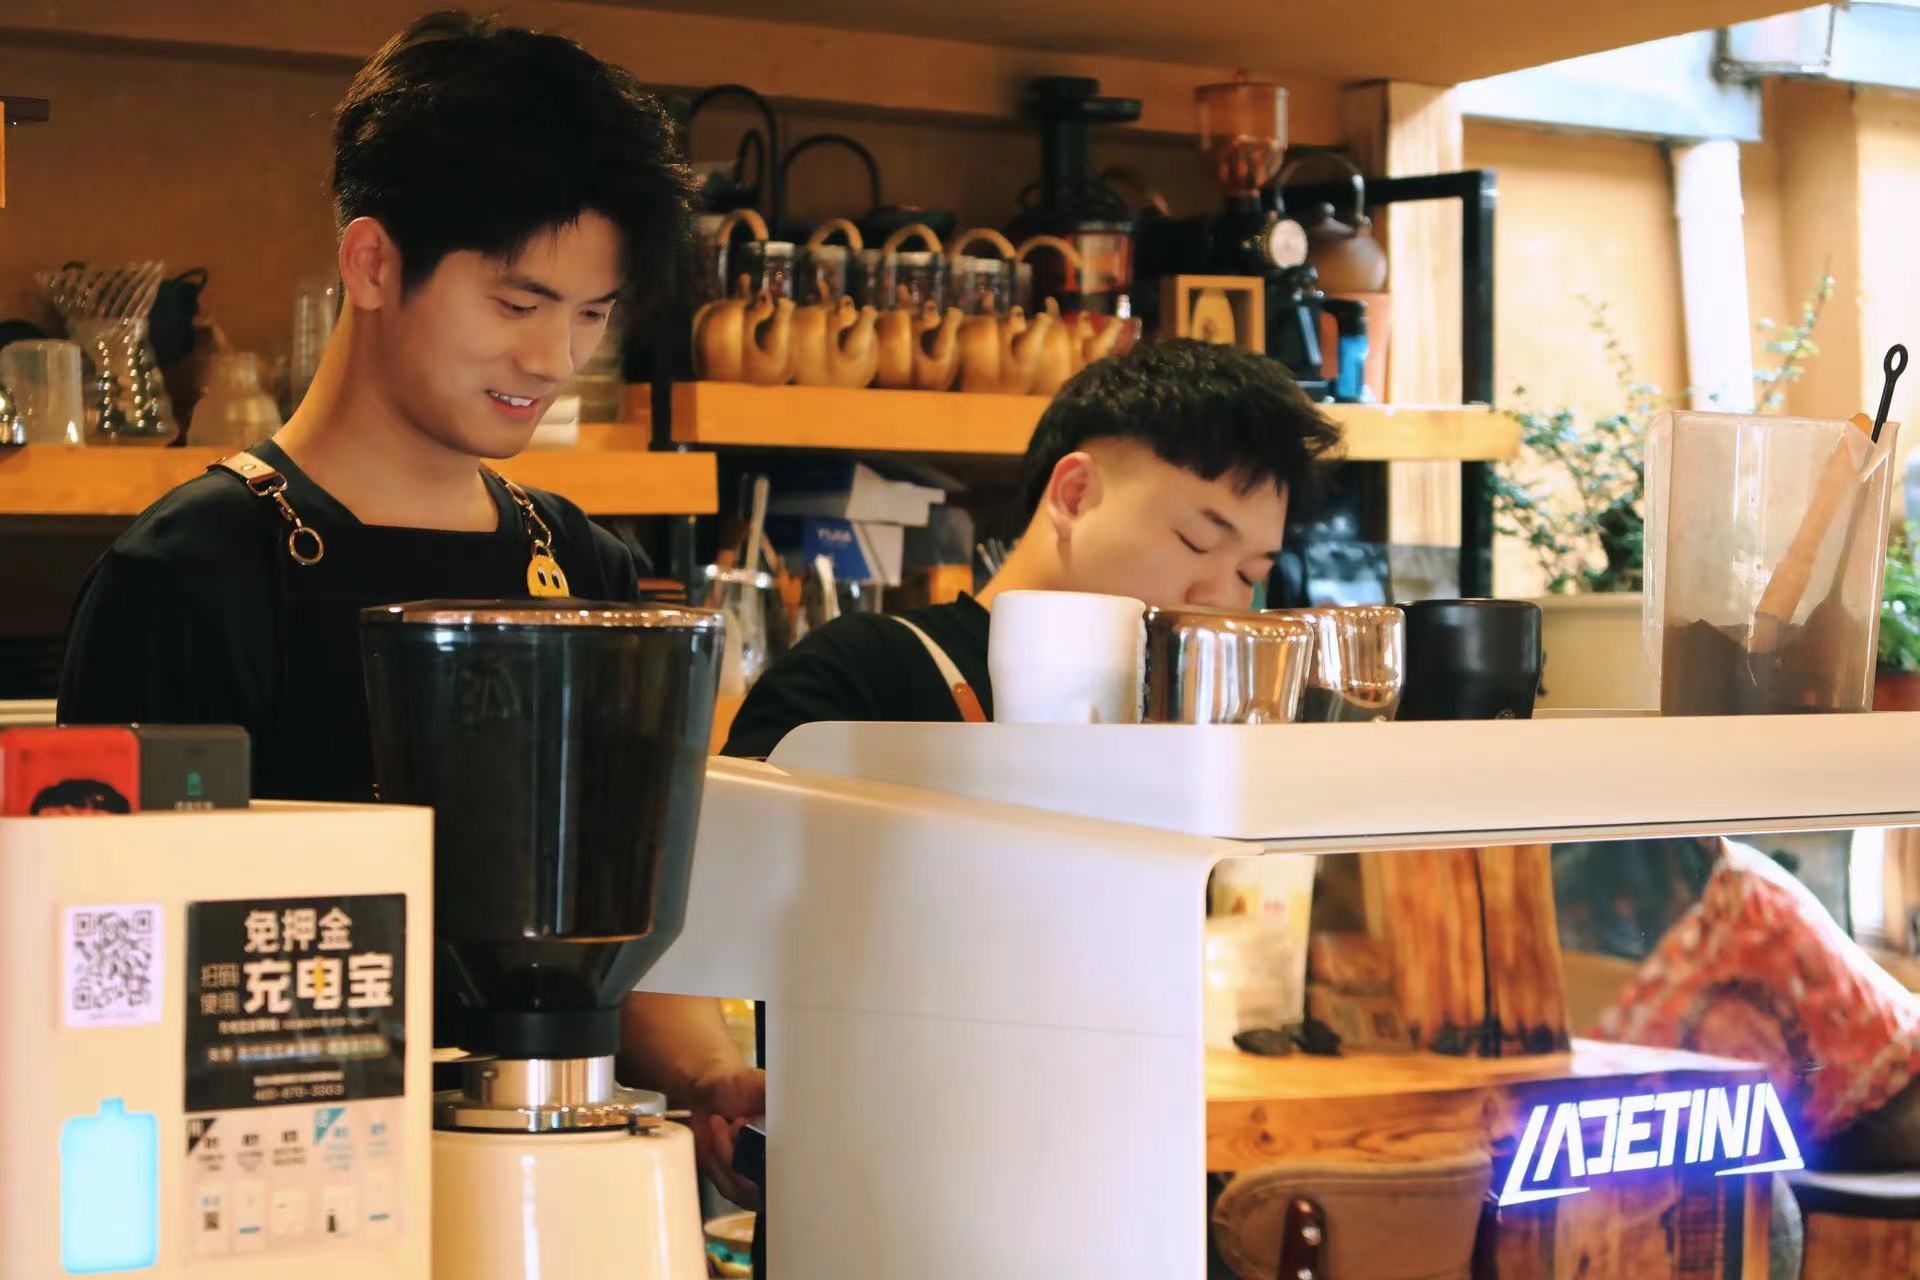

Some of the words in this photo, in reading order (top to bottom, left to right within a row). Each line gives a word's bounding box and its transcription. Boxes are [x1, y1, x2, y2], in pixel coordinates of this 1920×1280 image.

[244, 906, 352, 954] 免押金
[243, 951, 394, 1014] 充电宝
